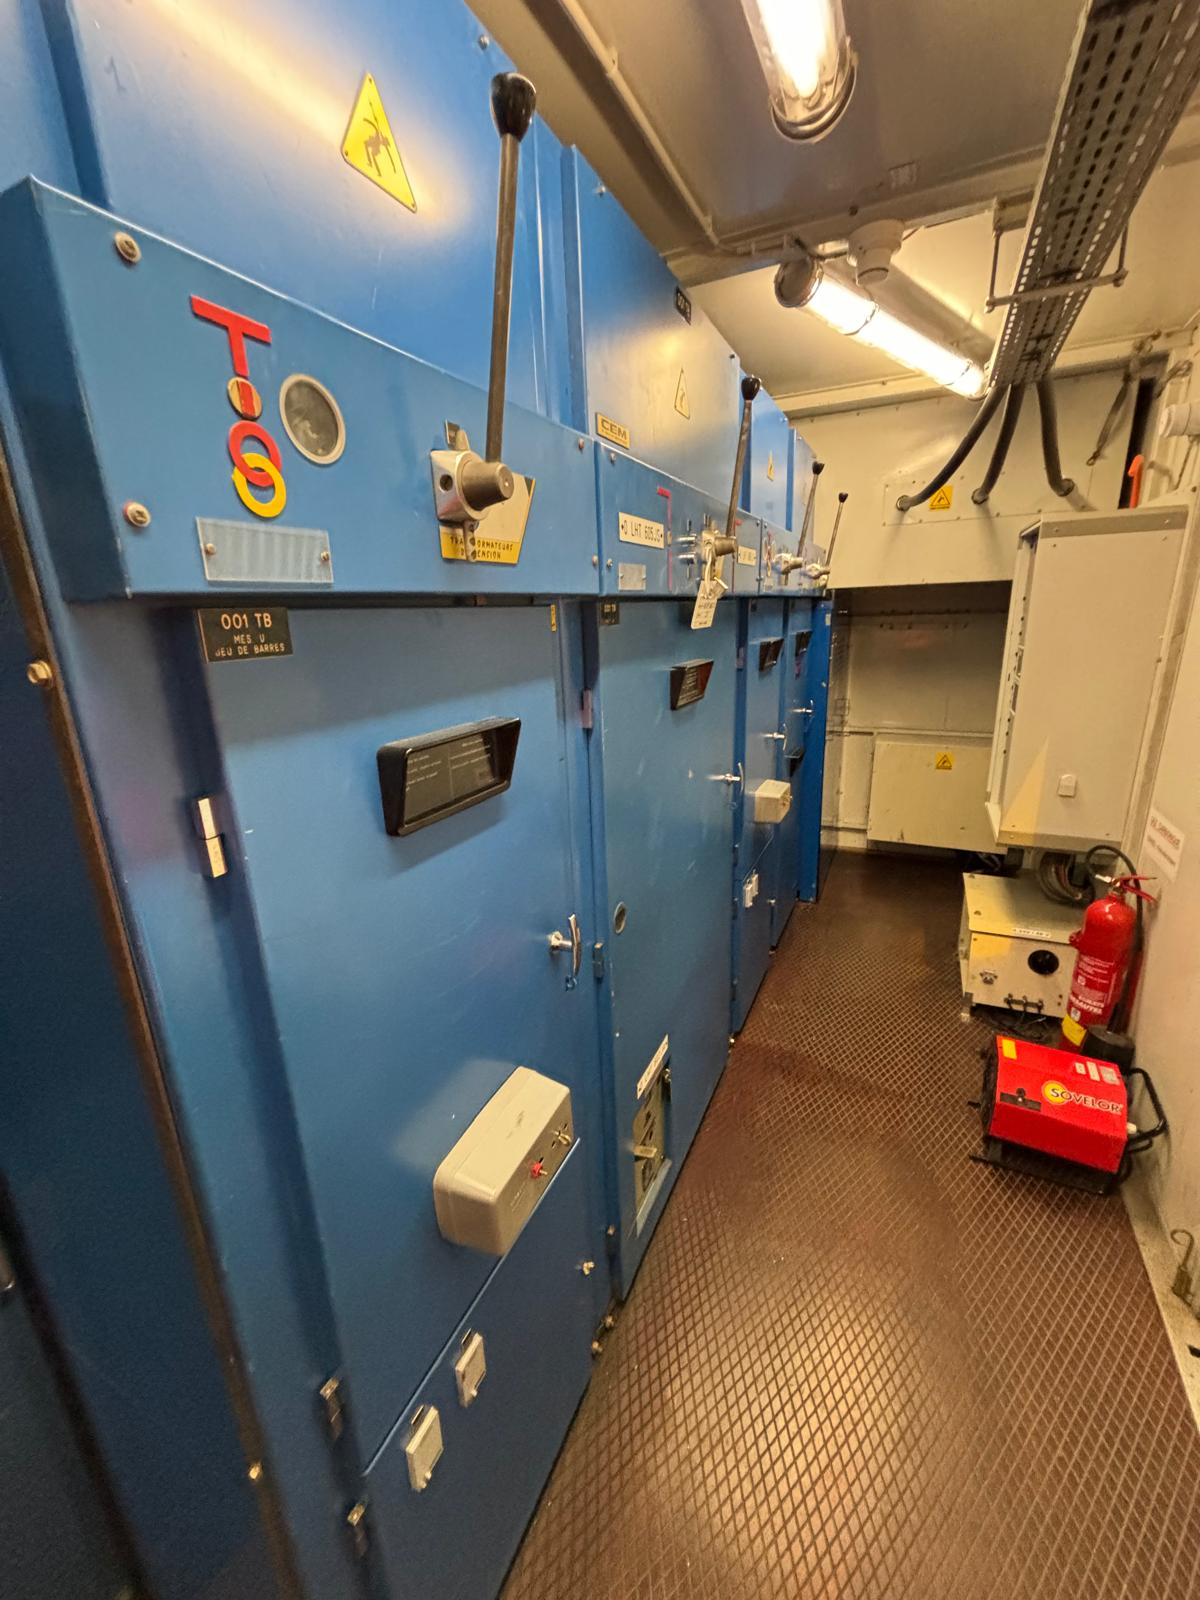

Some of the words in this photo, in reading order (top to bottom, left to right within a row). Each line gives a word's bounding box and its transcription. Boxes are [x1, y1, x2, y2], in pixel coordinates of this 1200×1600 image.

[600, 418, 628, 441] CEM
[450, 535, 513, 552] TRAORMATEURS
[477, 549, 501, 559] ENSION
[221, 613, 249, 630] 001
[254, 612, 272, 628] TB
[233, 634, 252, 645] MES
[259, 633, 266, 643] U
[215, 647, 232, 657] JEU
[237, 645, 249, 655] DE
[253, 642, 285, 654] BARRES
[1050, 1087, 1121, 1114] SOVELOR
